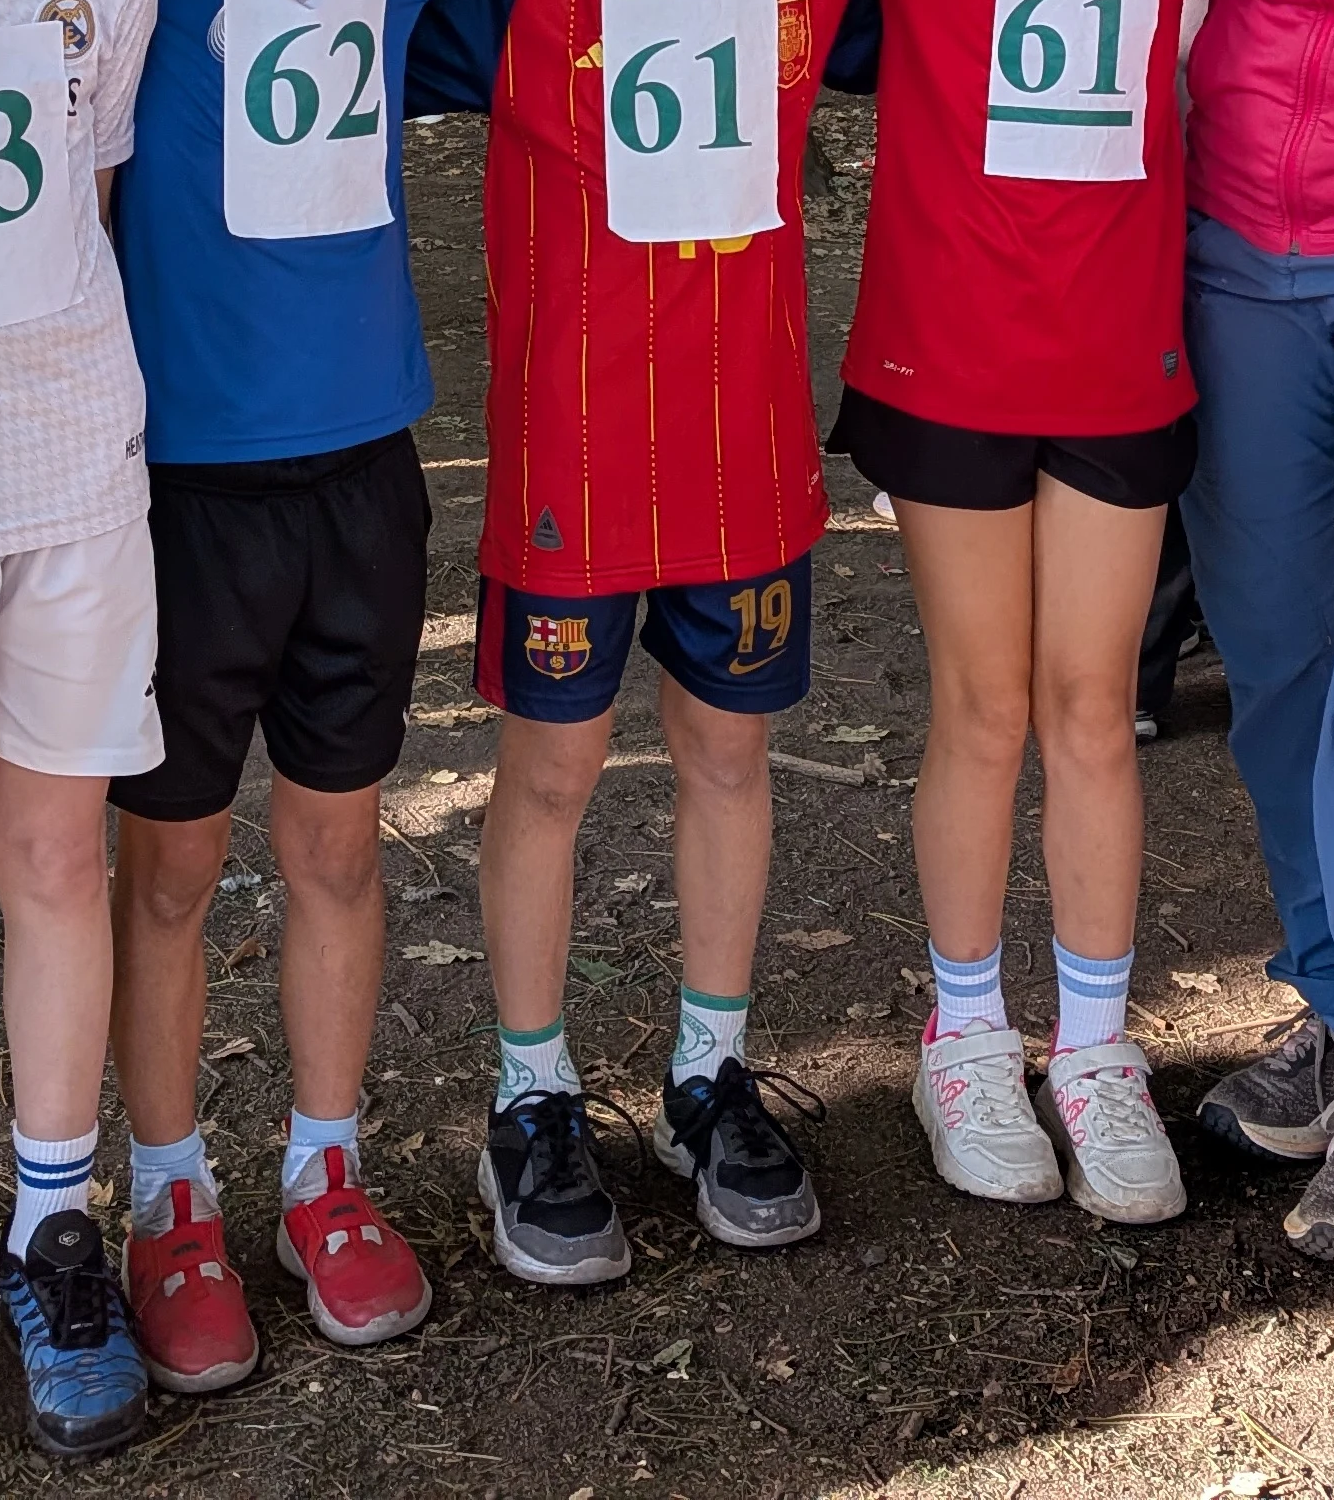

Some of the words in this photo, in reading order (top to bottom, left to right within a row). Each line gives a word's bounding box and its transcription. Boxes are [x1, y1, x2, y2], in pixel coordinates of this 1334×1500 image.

[244, 20, 380, 146] 62
[609, 36, 752, 154] 61
[730, 579, 792, 653] 19
